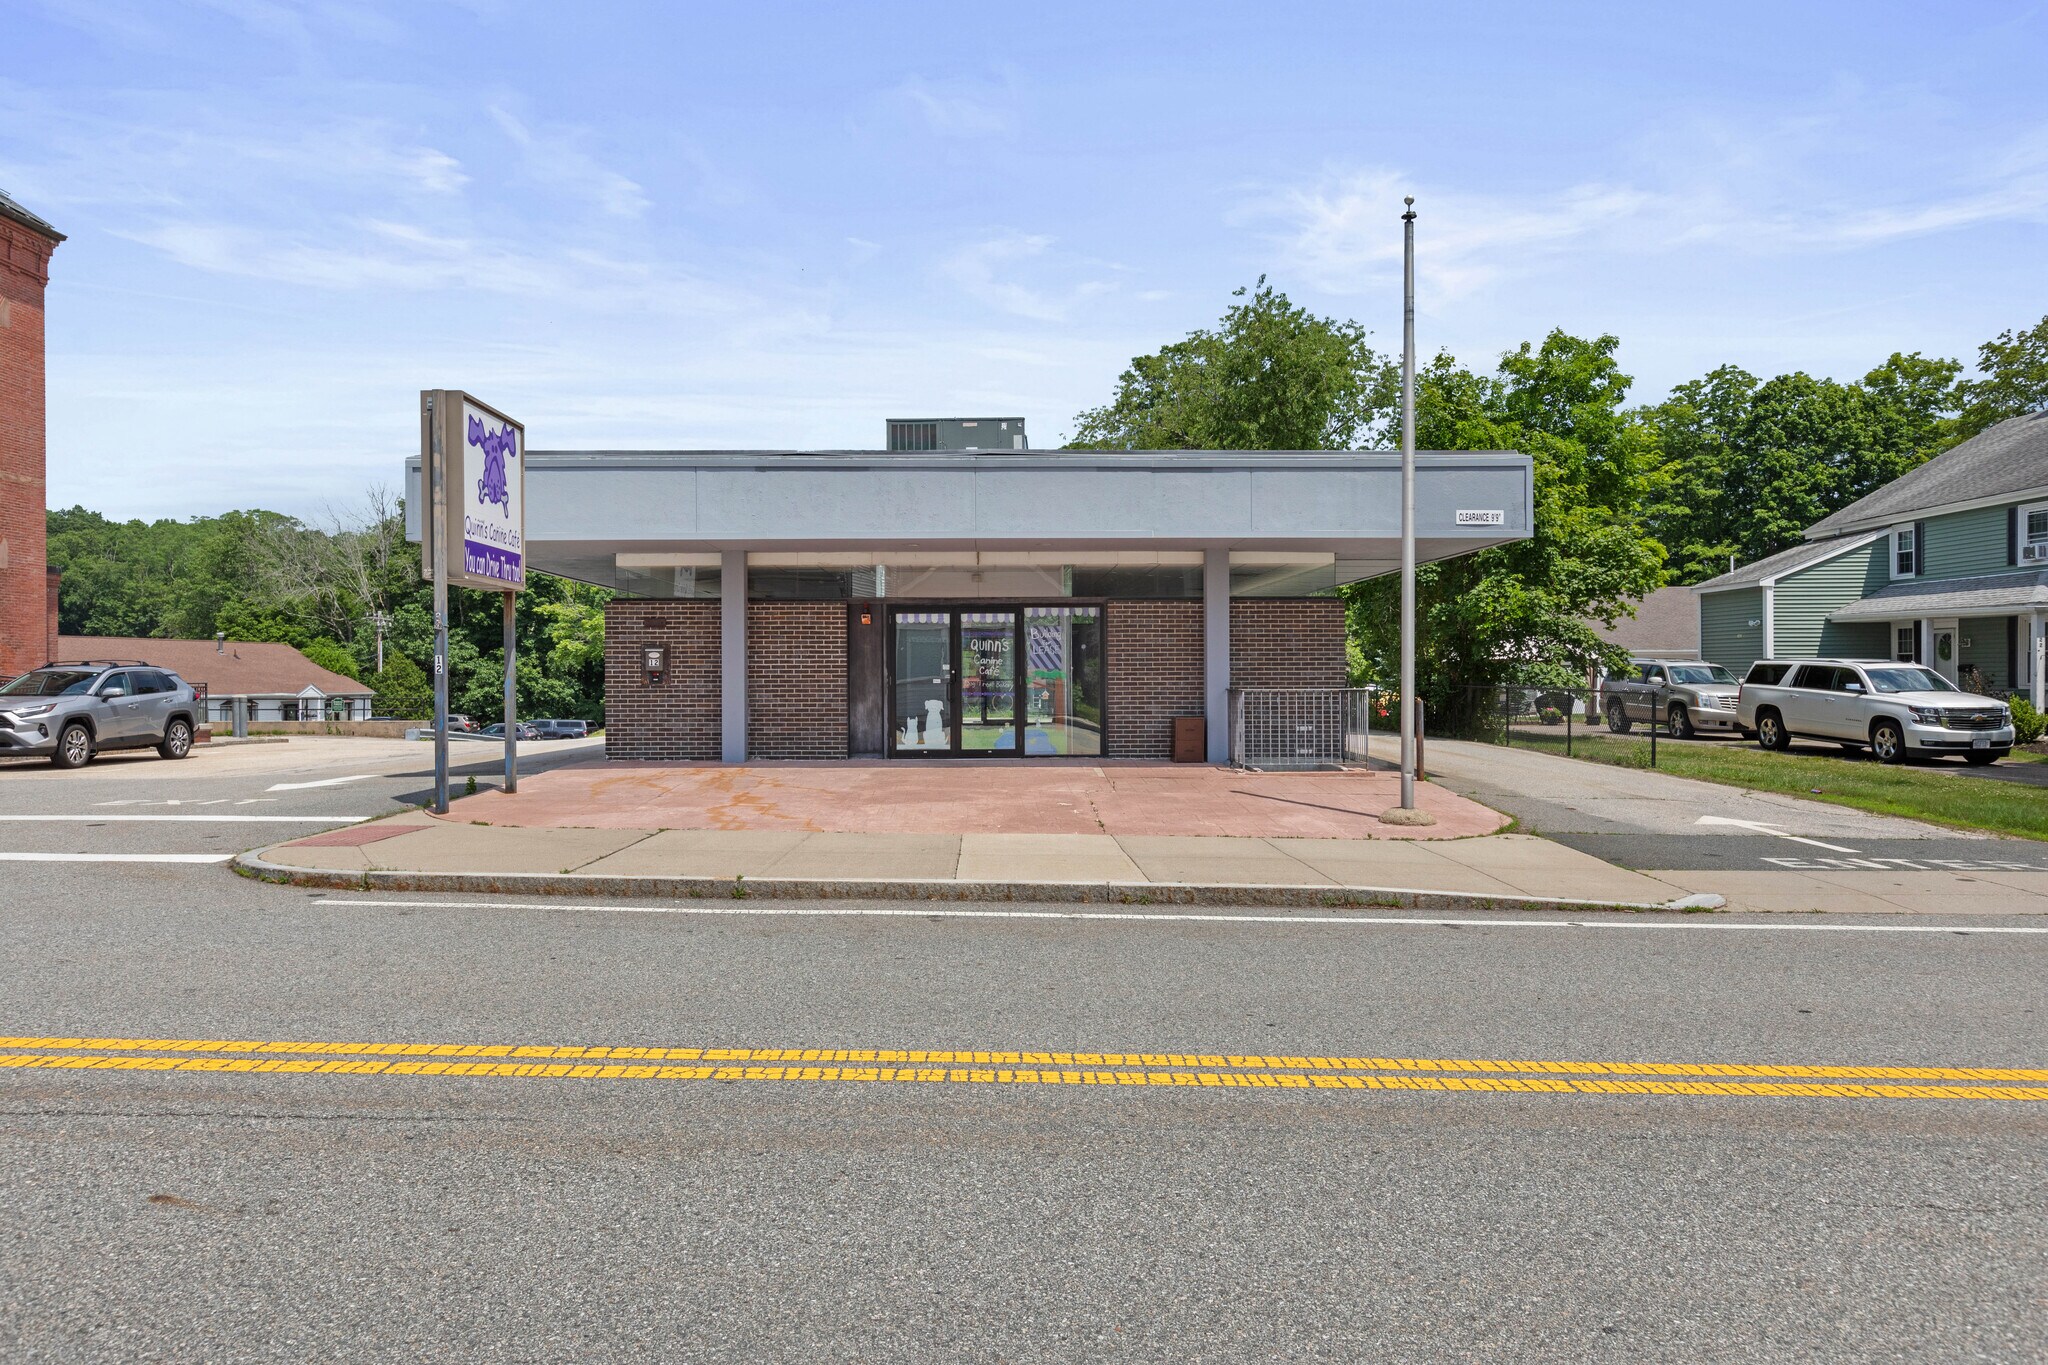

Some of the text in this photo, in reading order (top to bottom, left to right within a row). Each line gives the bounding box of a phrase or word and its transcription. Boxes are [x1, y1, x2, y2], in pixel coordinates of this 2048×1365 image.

[1458, 512, 1490, 522] CLEARANCE
[465, 546, 476, 573] You
[476, 556, 486, 575] can
[486, 551, 500, 578] Drive
[500, 555, 512, 581] Thru
[973, 654, 1003, 665] Canine
[1759, 858, 2048, 870] ENTER
